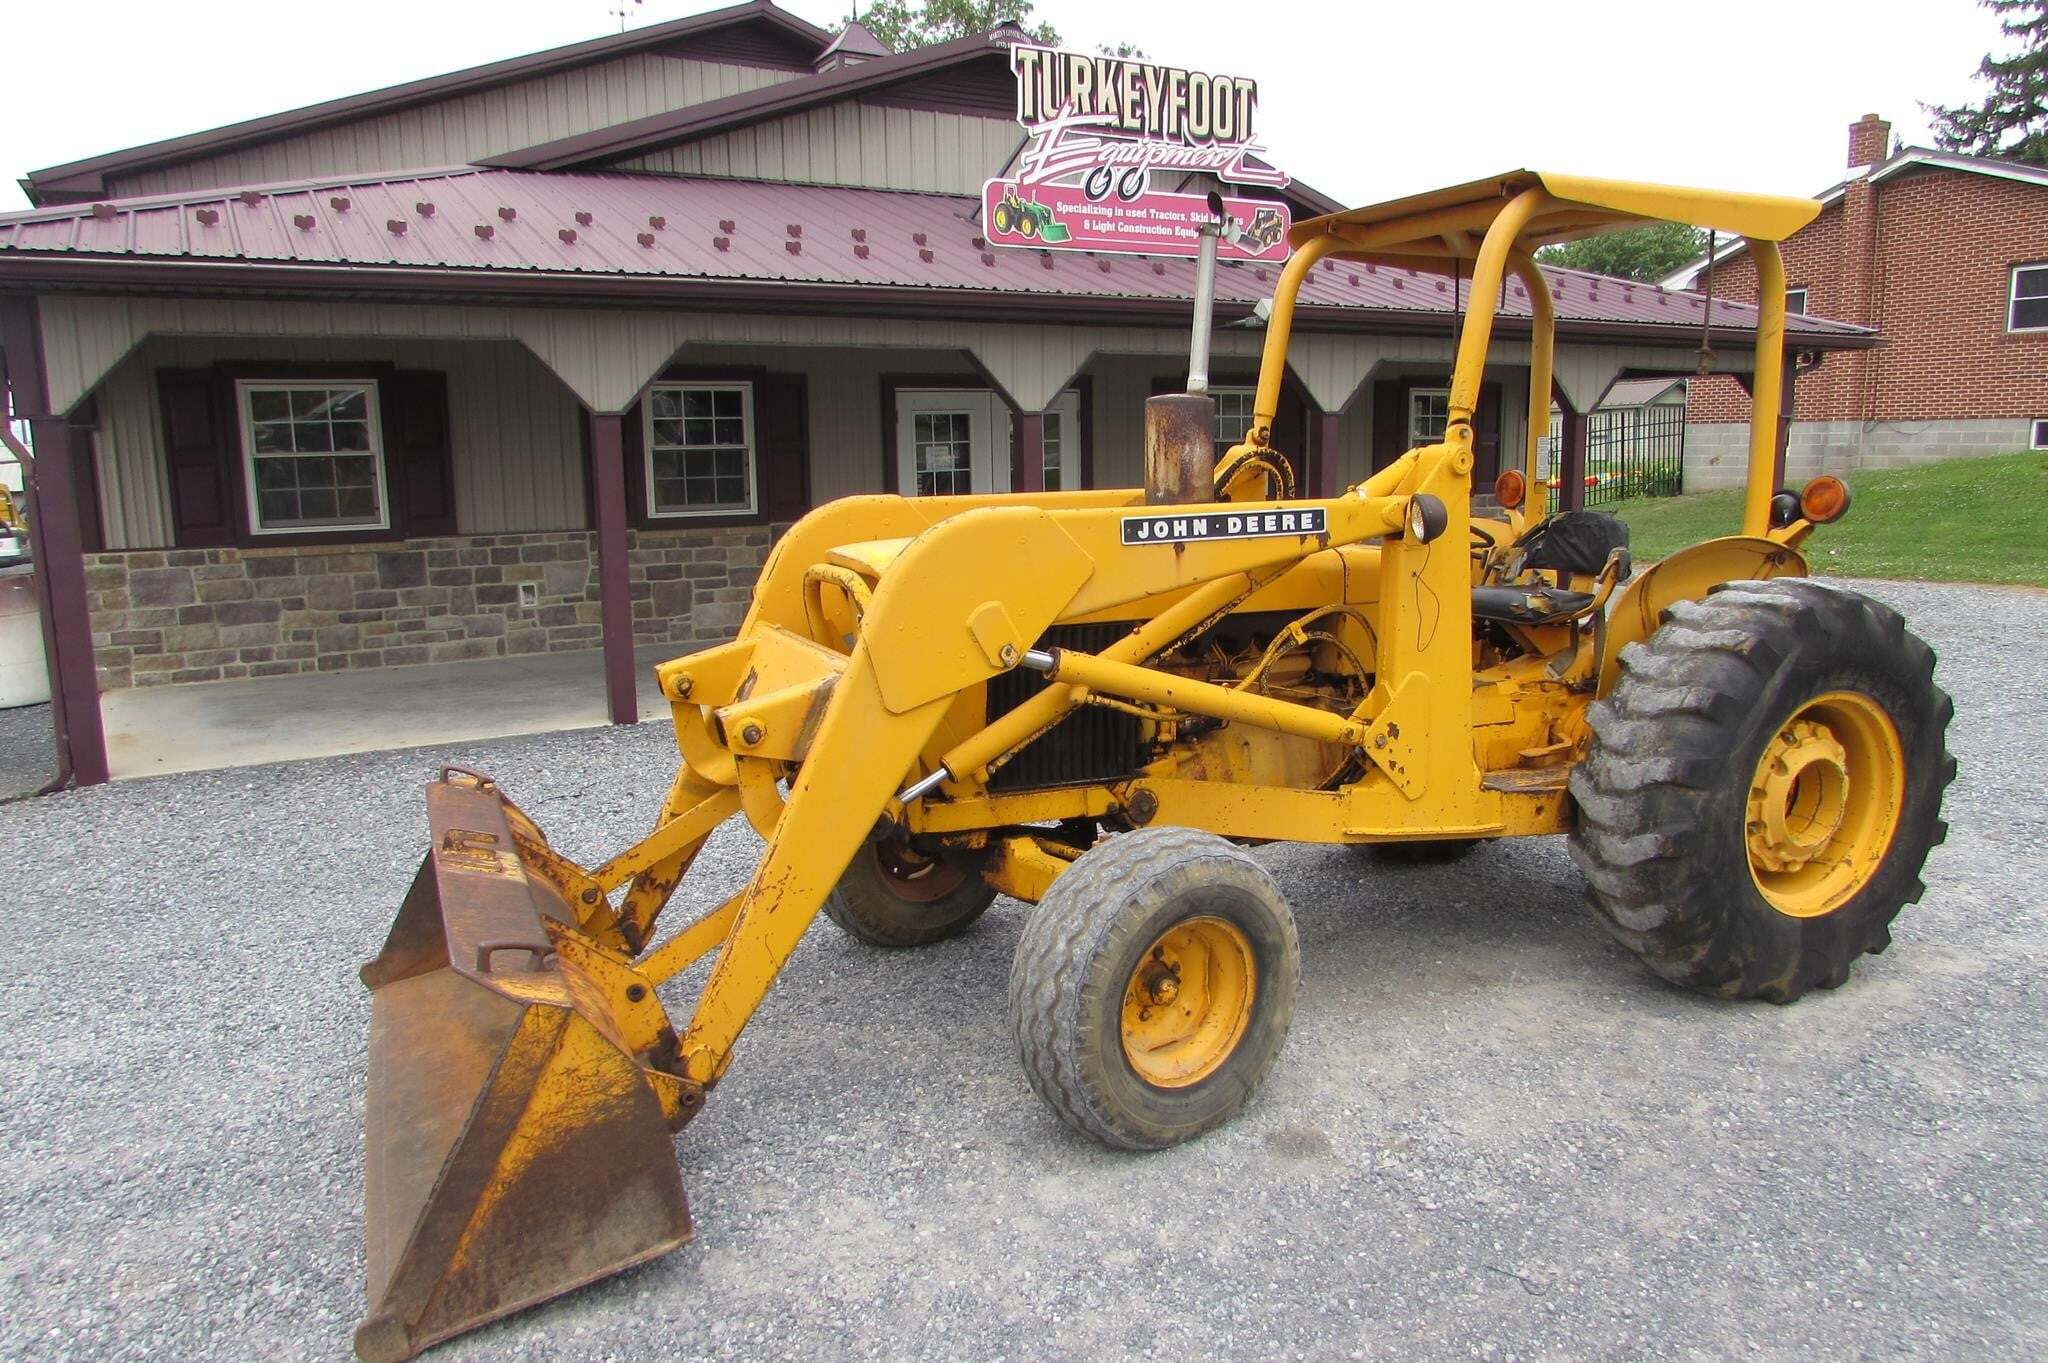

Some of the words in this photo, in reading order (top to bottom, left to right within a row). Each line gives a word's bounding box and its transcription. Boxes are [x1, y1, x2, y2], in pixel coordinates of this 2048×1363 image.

[1016, 47, 1256, 144] TURKEYFOOT
[1022, 101, 1286, 192] Equipment
[1056, 201, 1113, 218] Specializing
[1114, 206, 1124, 217] in
[1126, 207, 1147, 218] used
[1150, 208, 1188, 223] Tractors,
[1190, 211, 1208, 222] Skid
[1210, 213, 1244, 226] Lors
[1083, 219, 1090, 230] &
[1093, 220, 1116, 233] Light
[1117, 221, 1173, 236] Construction
[1174, 226, 1199, 239] Equip
[1137, 518, 1208, 540] JOHN
[1227, 512, 1313, 534] DEERE
